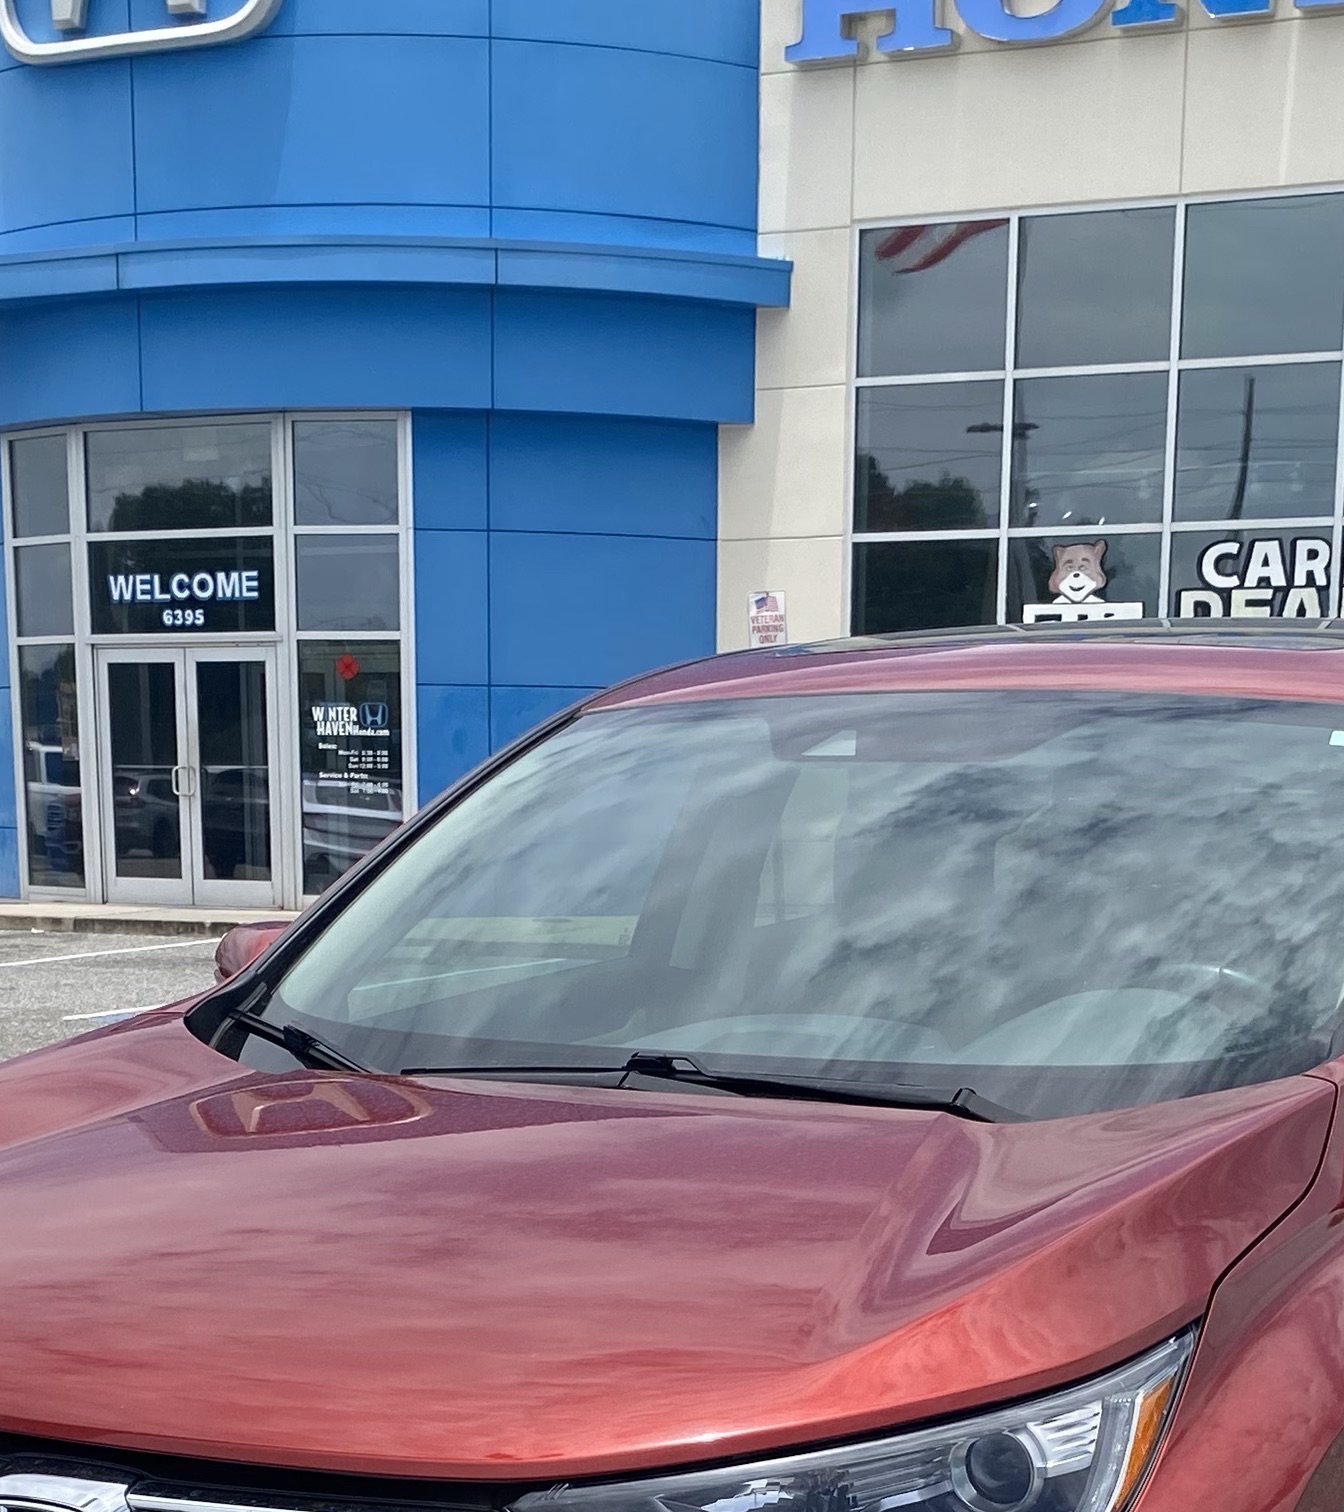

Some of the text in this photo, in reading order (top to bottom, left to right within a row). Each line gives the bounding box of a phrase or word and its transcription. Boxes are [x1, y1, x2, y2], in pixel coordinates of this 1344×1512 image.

[108, 570, 260, 602] WELCOME
[162, 609, 205, 626] 6395
[751, 614, 785, 625] VETERAN
[752, 624, 784, 634] PARKING
[759, 634, 777, 644] ONLY
